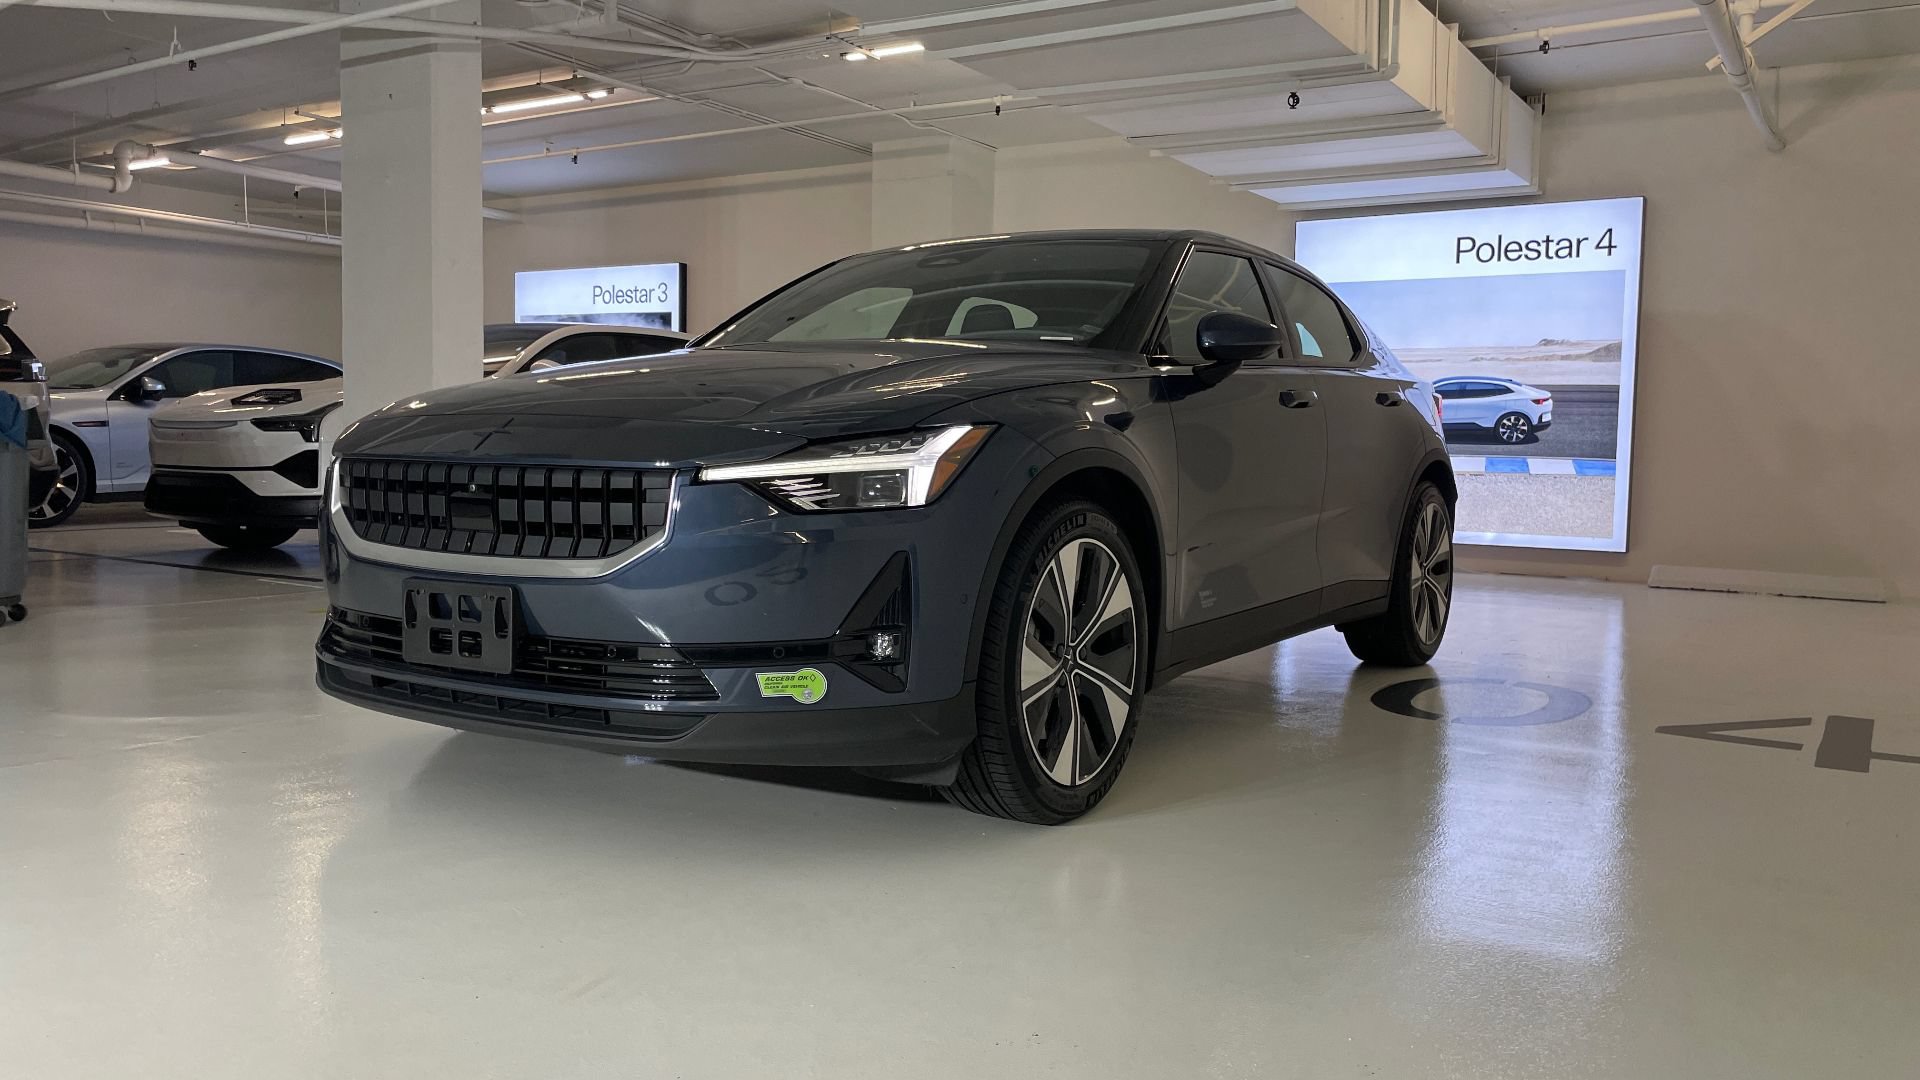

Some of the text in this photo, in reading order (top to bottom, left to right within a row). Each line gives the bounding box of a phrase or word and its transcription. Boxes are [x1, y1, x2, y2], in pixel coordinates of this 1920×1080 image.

[1456, 227, 1617, 264] Polestar 4
[592, 282, 668, 305] Polestar 3
[1034, 513, 1087, 571] MICHELIN
